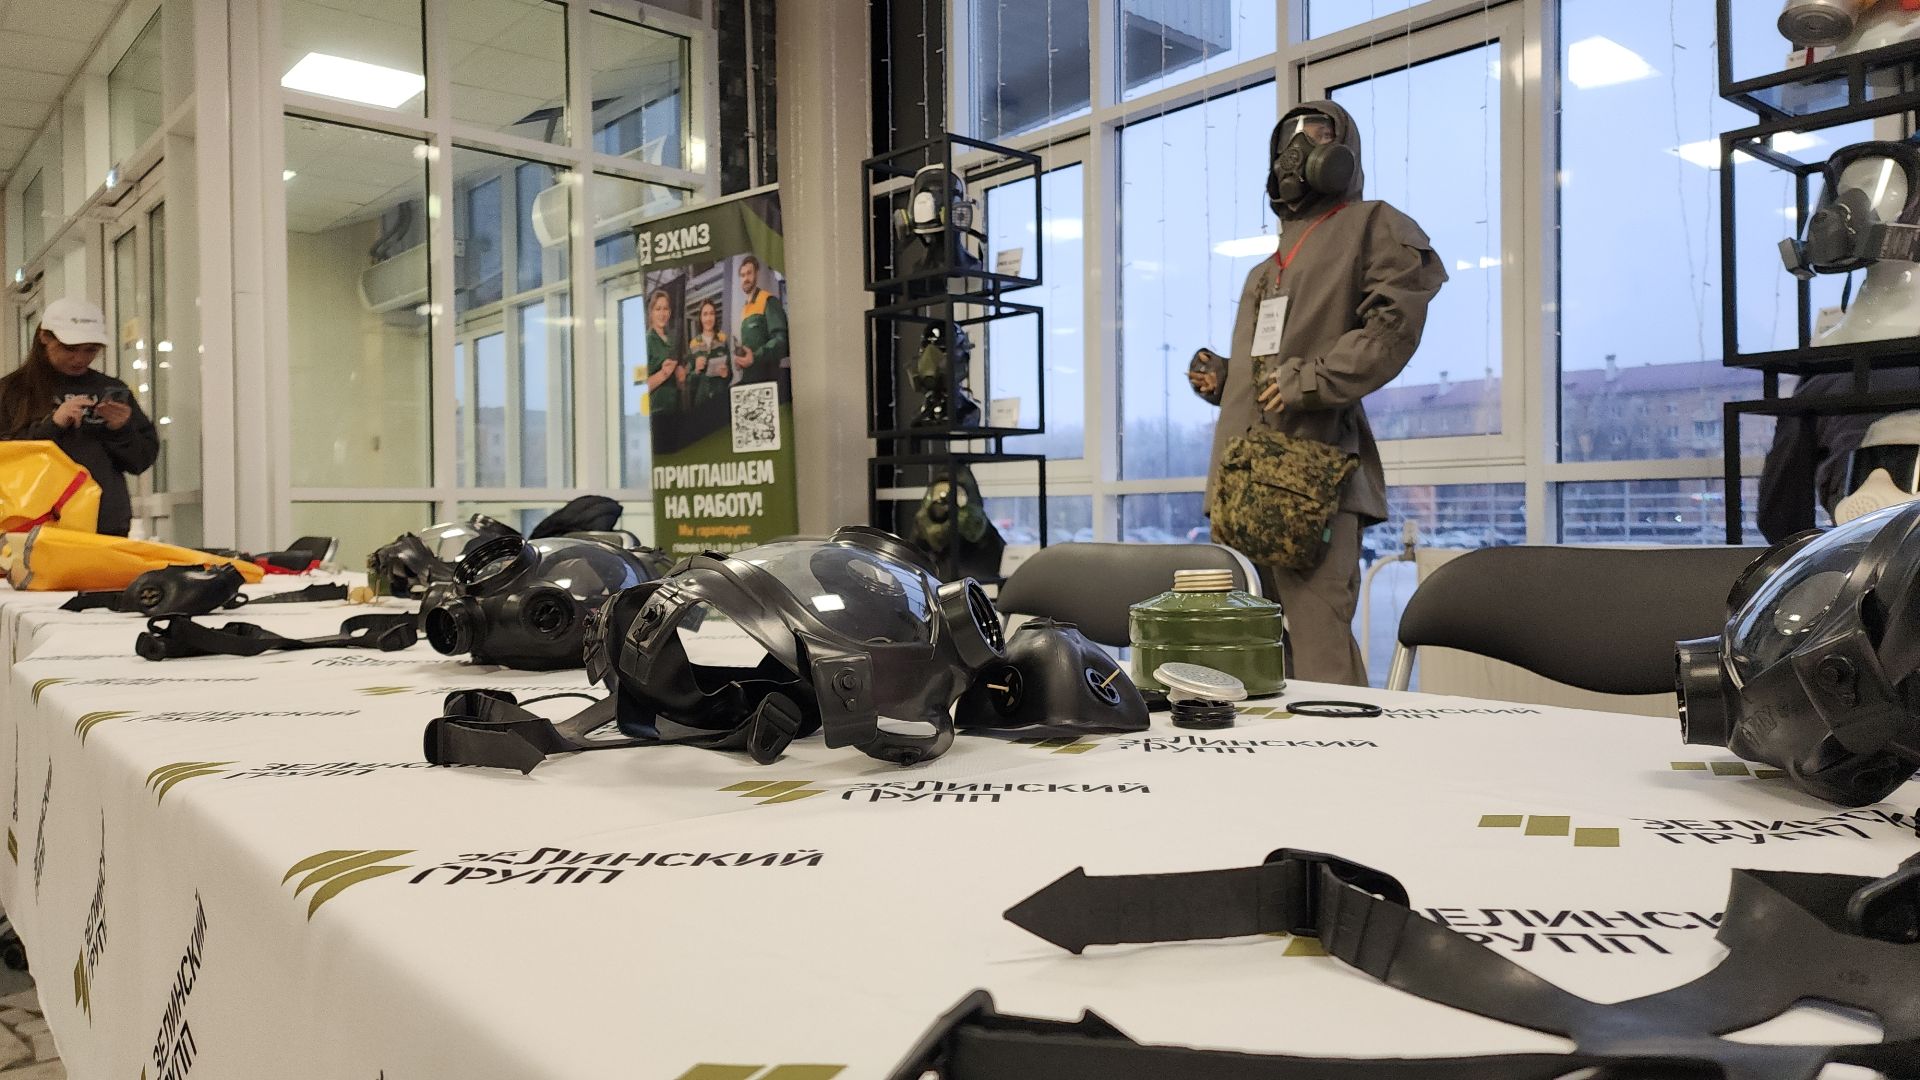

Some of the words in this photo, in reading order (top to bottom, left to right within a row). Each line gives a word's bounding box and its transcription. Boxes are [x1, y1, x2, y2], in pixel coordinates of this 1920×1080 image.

[654, 223, 711, 254] ЭХМЗ
[653, 459, 775, 490] ПРИГЛАШАЕМ
[664, 495, 690, 519] НА
[693, 492, 763, 518] РАБОТУ!
[1118, 735, 1379, 748] ЗЕЛИНСКИЙ
[222, 769, 376, 779] ГРУПП
[841, 788, 1001, 803] ГРУПП
[850, 780, 1151, 794] ЗЕЛИНСКИЙ
[1656, 823, 1873, 845] ГРУПП
[440, 847, 826, 867] ЗЕЛИНСКИЙ
[407, 864, 626, 885] ГРУПП
[153, 887, 208, 1080] ЗЕЛИНСКИЙ
